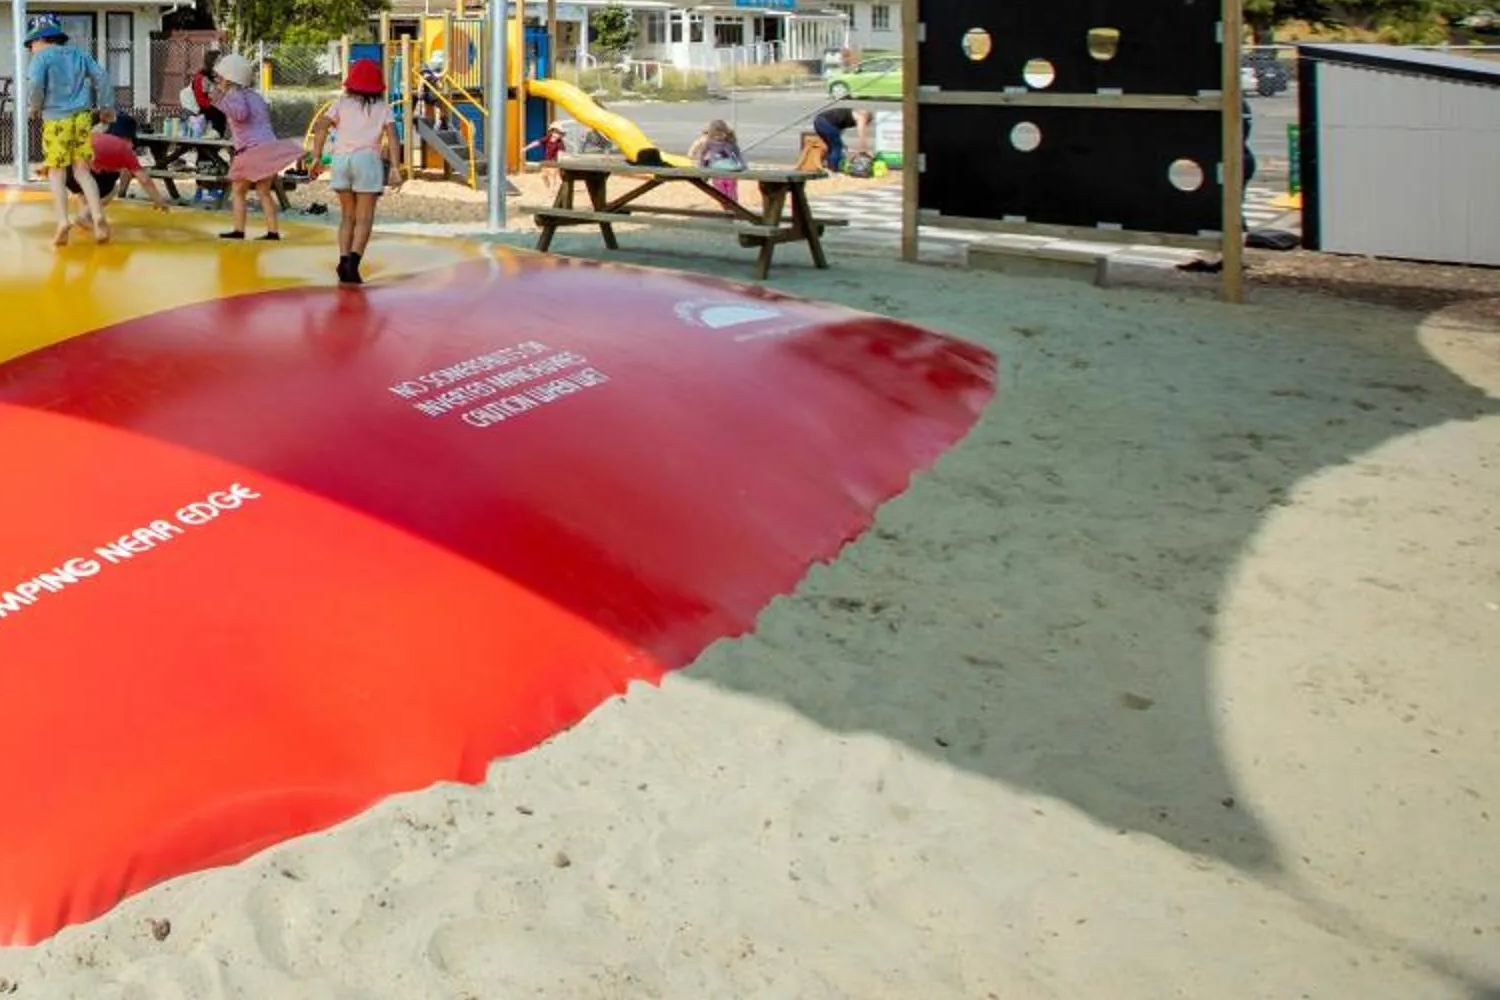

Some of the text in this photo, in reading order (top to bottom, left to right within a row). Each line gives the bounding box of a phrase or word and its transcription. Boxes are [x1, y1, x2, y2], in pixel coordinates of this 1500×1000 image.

[389, 381, 429, 400] NO
[461, 396, 539, 427] CAUTION
[95, 519, 183, 563] NEAR
[175, 483, 260, 524] EDGE
